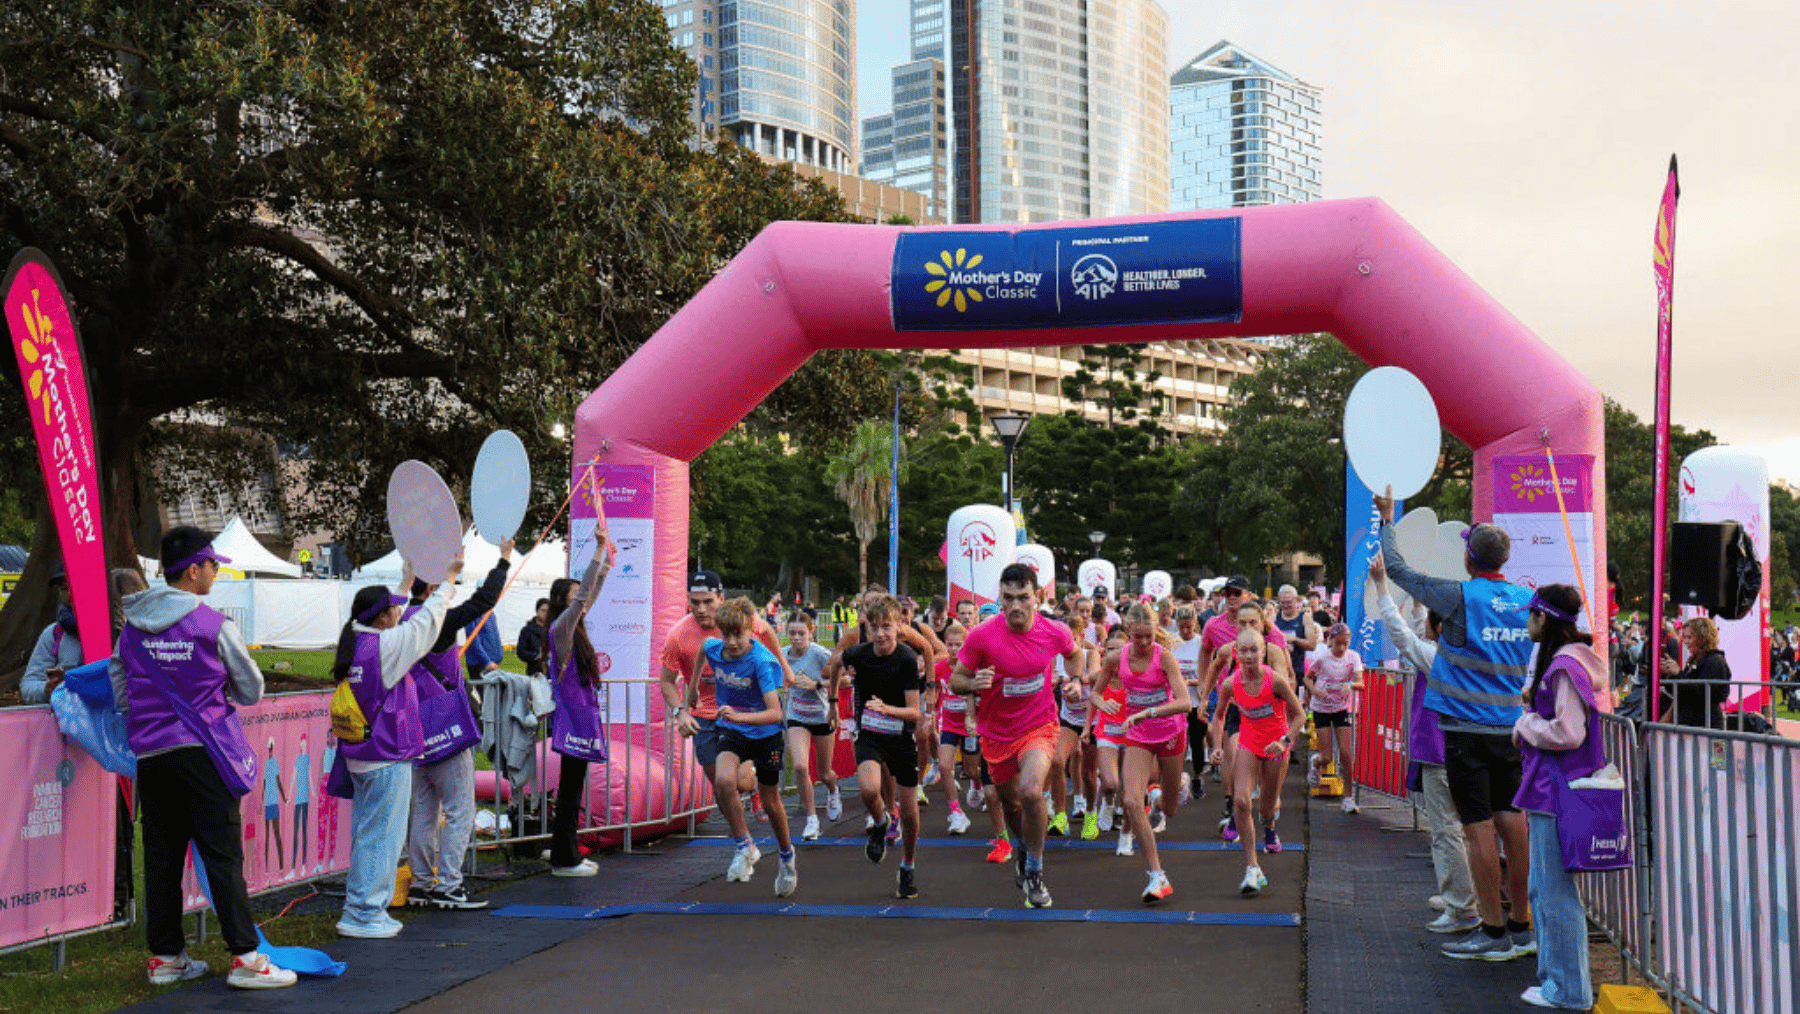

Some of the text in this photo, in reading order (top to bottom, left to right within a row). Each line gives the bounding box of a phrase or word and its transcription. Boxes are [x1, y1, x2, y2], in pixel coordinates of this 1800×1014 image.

[1071, 235, 1150, 247] PRINCIPAL PARTNER
[948, 271, 1043, 287] Mother's Day
[1123, 279, 1181, 292] BETTER LIVES
[985, 285, 1038, 299] Classic
[41, 352, 80, 483] Mother's
[76, 483, 96, 543] Day
[53, 436, 83, 545] Classic
[1481, 626, 1530, 642] STAFF
[10, 890, 41, 909] THEIR
